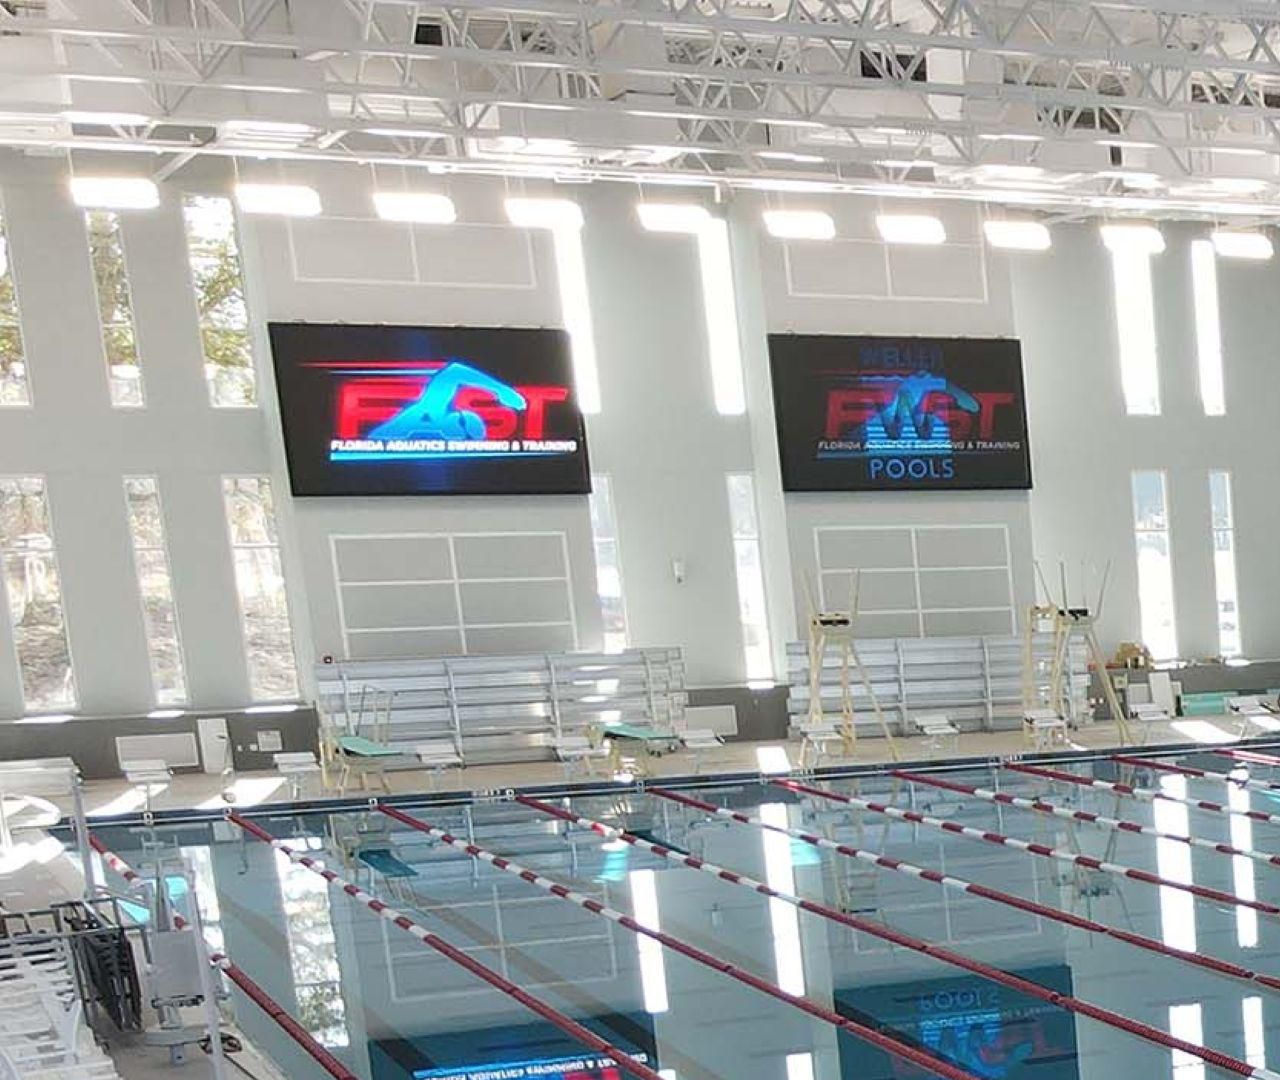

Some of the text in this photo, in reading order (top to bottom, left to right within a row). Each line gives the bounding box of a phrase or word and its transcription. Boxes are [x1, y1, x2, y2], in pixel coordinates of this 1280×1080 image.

[336, 363, 568, 440] FAST
[331, 440, 383, 452] FLORIDA
[386, 440, 445, 452] AQUATICS
[522, 440, 577, 452] TRAINING
[818, 440, 861, 450] FLORIDA
[976, 440, 1020, 450] TRAINING
[869, 458, 954, 479] POOLS
